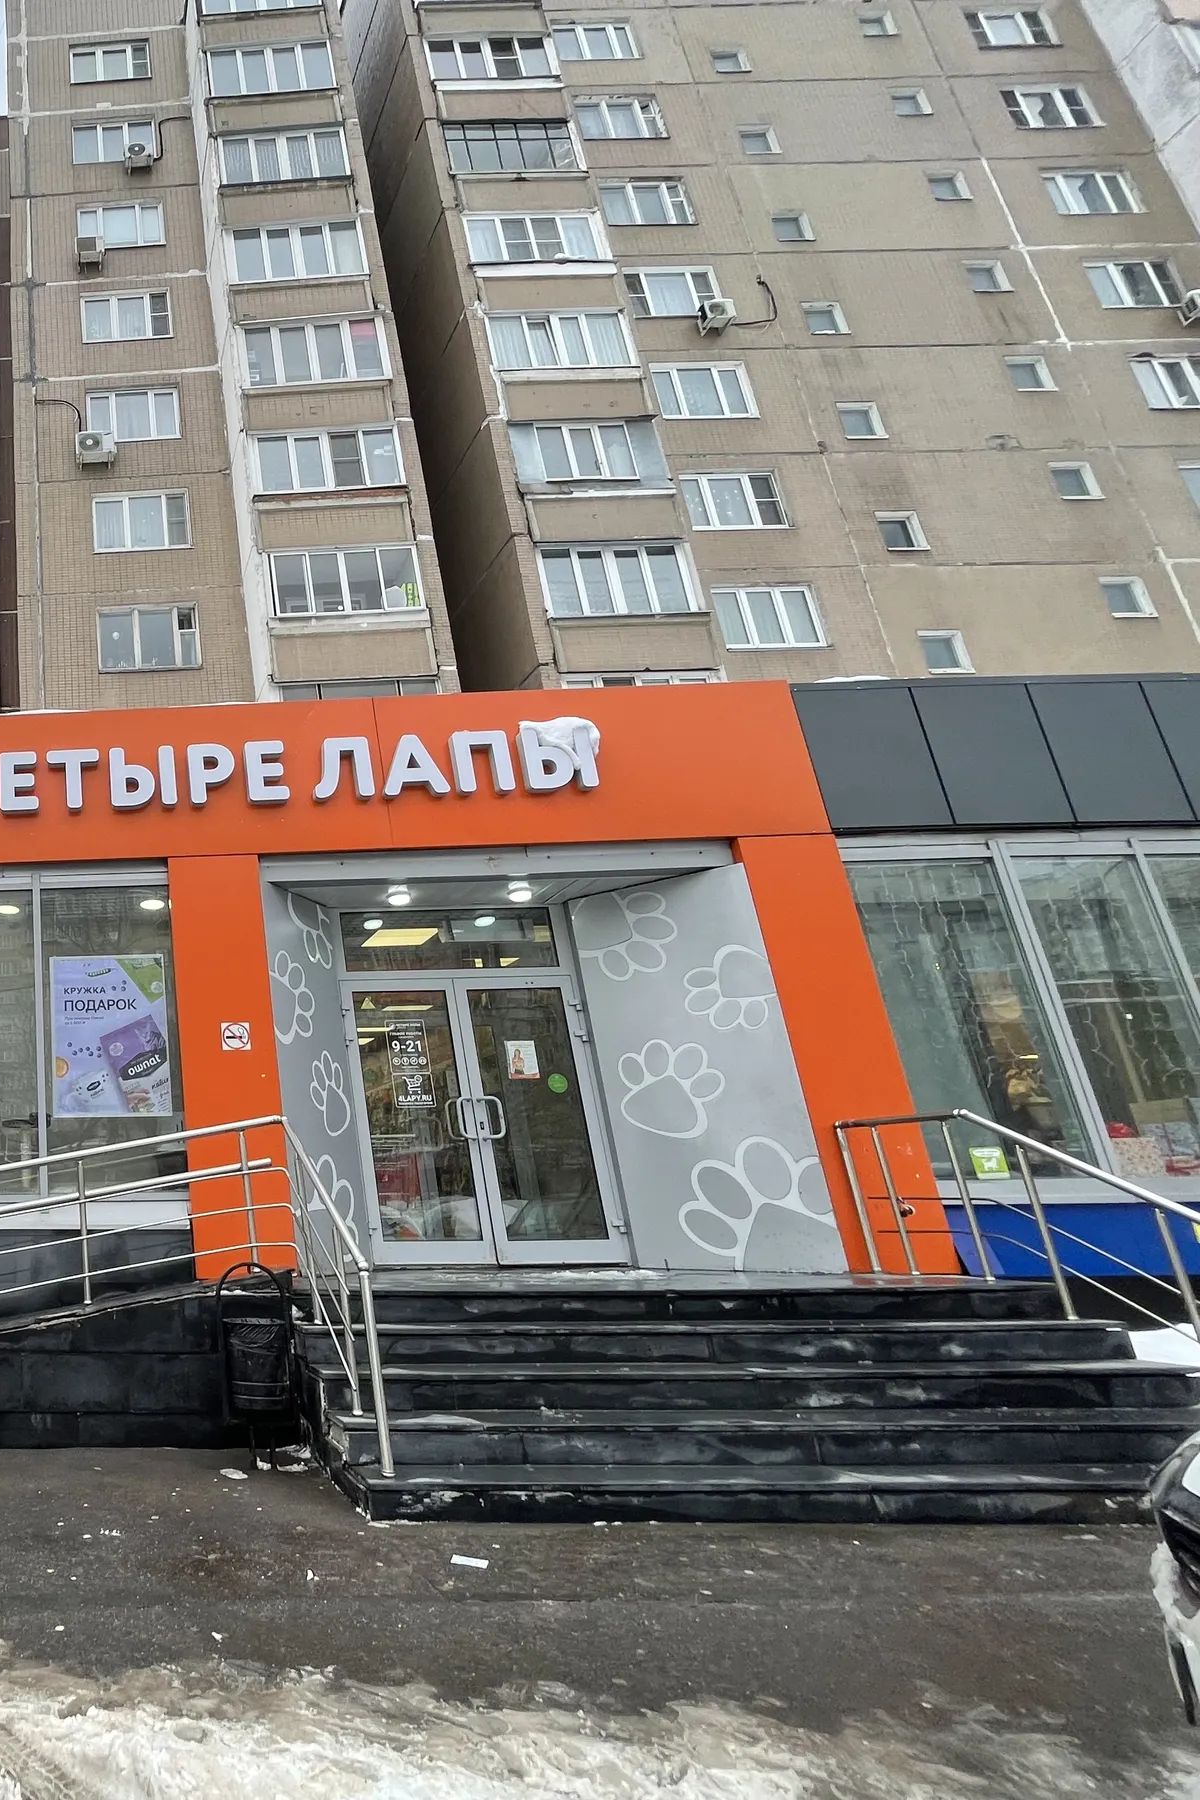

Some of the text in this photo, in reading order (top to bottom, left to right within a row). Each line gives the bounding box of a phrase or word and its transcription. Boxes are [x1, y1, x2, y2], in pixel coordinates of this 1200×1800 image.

[313, 722, 601, 802] ЛАПЫ
[63, 986, 107, 995] КРУЖКА
[64, 998, 137, 1013] ПОДАРОК
[391, 1040, 422, 1053] 9-21
[127, 1053, 162, 1076] ownat
[398, 1094, 433, 1102] 4LAPY.RU
